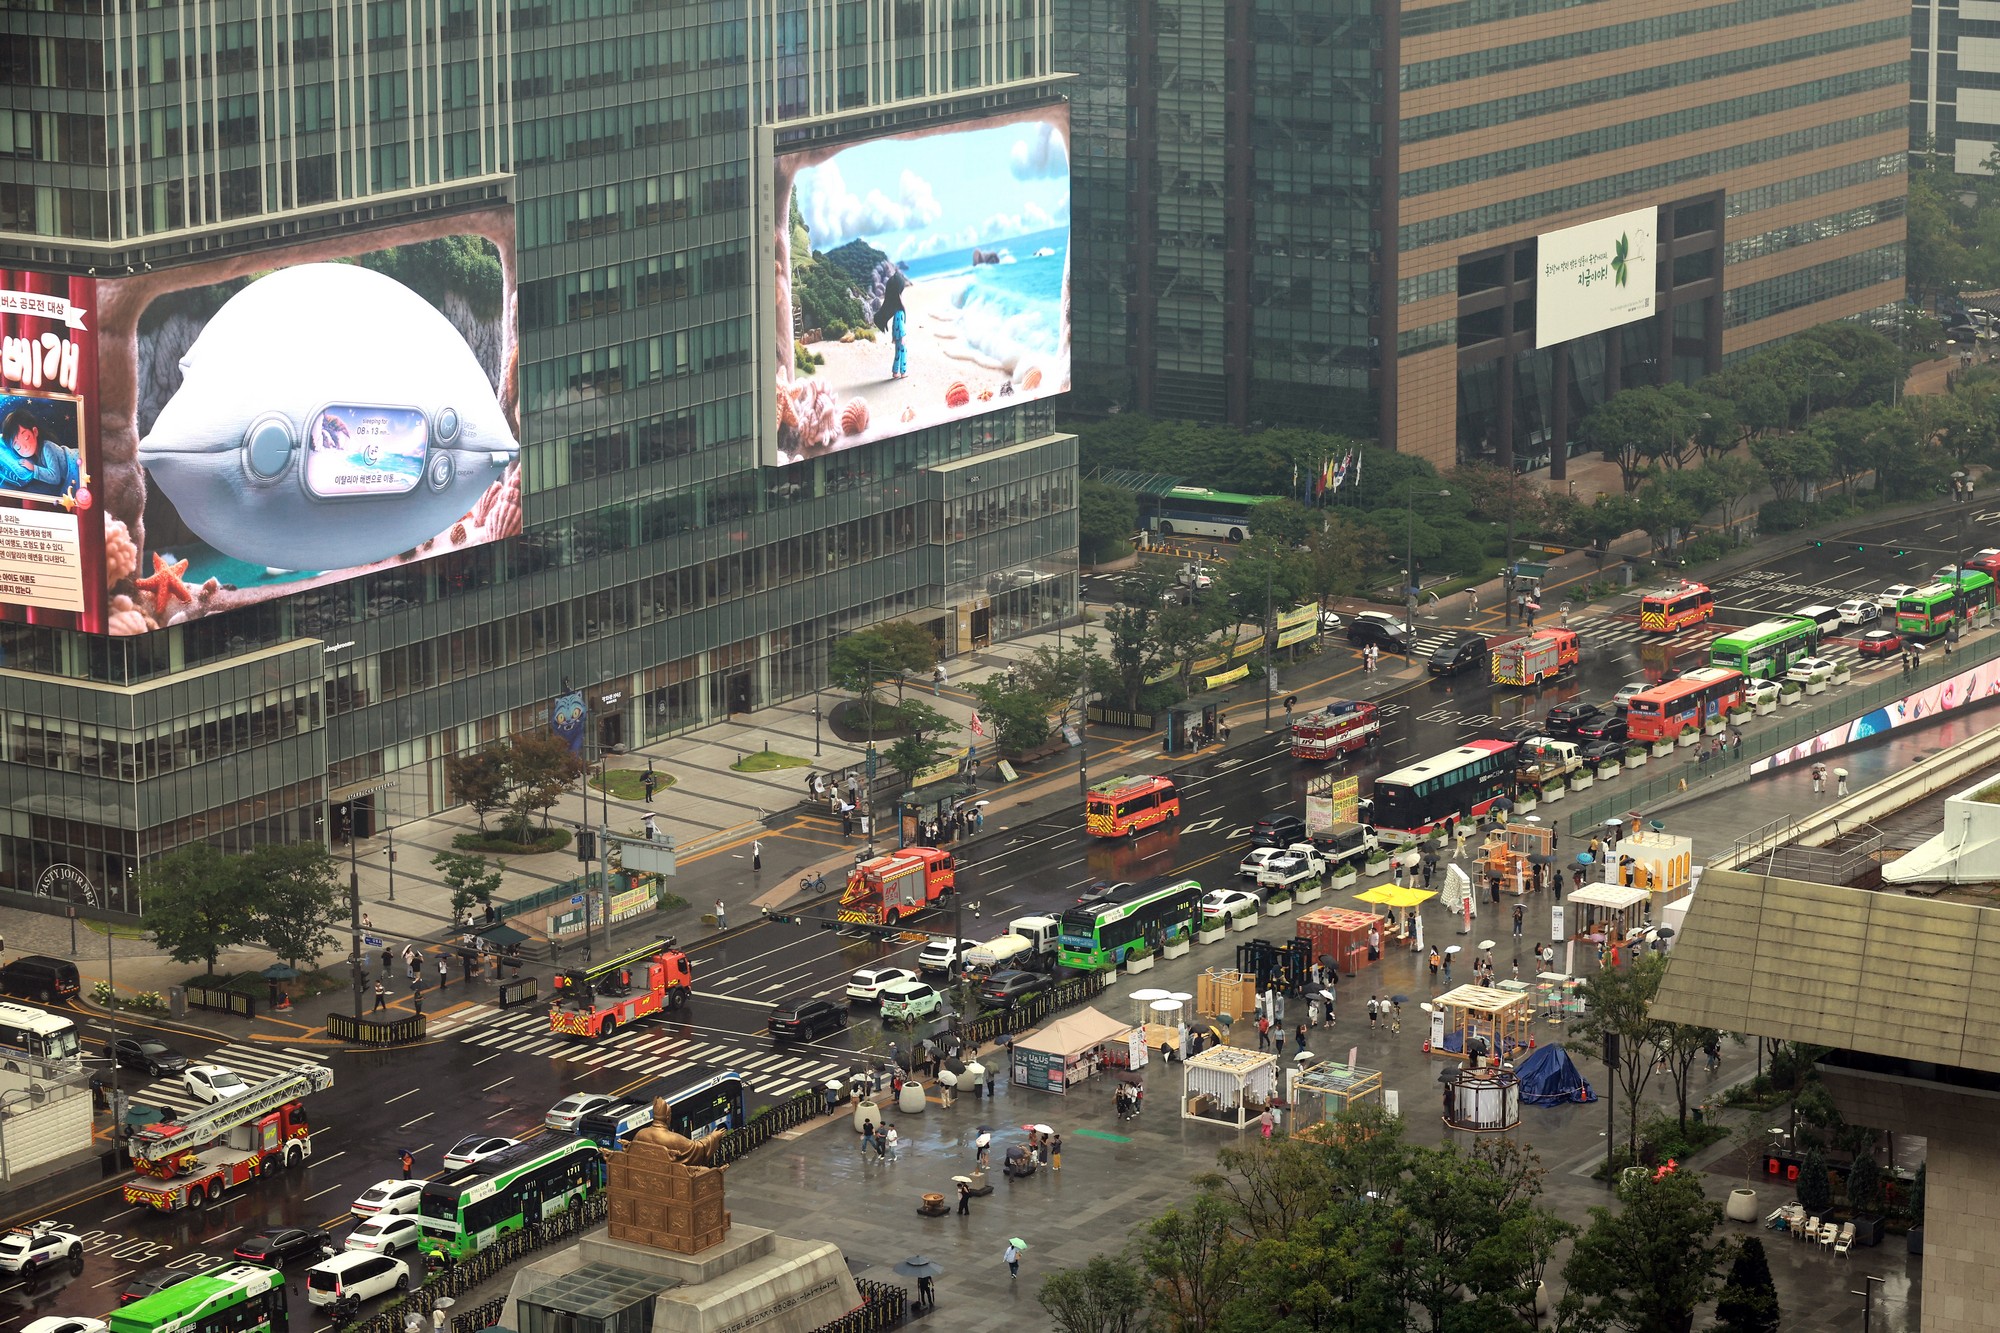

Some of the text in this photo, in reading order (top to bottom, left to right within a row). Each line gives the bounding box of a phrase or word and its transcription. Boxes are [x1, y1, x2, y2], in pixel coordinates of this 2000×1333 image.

[1577, 265, 1608, 287] 지금이야!
[0, 296, 64, 315] 버스 공모전 대상
[0, 332, 80, 392] 베개
[356, 427, 366, 435] 08
[371, 427, 379, 435] 13
[334, 475, 359, 485] 이탈리아
[359, 474, 382, 484] 해변으로
[4, 514, 20, 524] 우리는
[20, 528, 41, 537] 꿈베개와
[41, 530, 52, 538] 함께
[23, 541, 39, 550] 모험도
[52, 544, 65, 552] 있다.
[6, 551, 27, 560] 이탈리아
[27, 552, 43, 562] 해변을
[2, 573, 36, 584] 아이도 어른도
[15, 585, 33, 595] 않는다.
[39, 868, 96, 907] TASTY JOURNEY
[1176, 901, 1189, 911] 7016
[565, 1145, 576, 1154] EV
[566, 1164, 580, 1177] 1711
[525, 1180, 536, 1191] 1711
